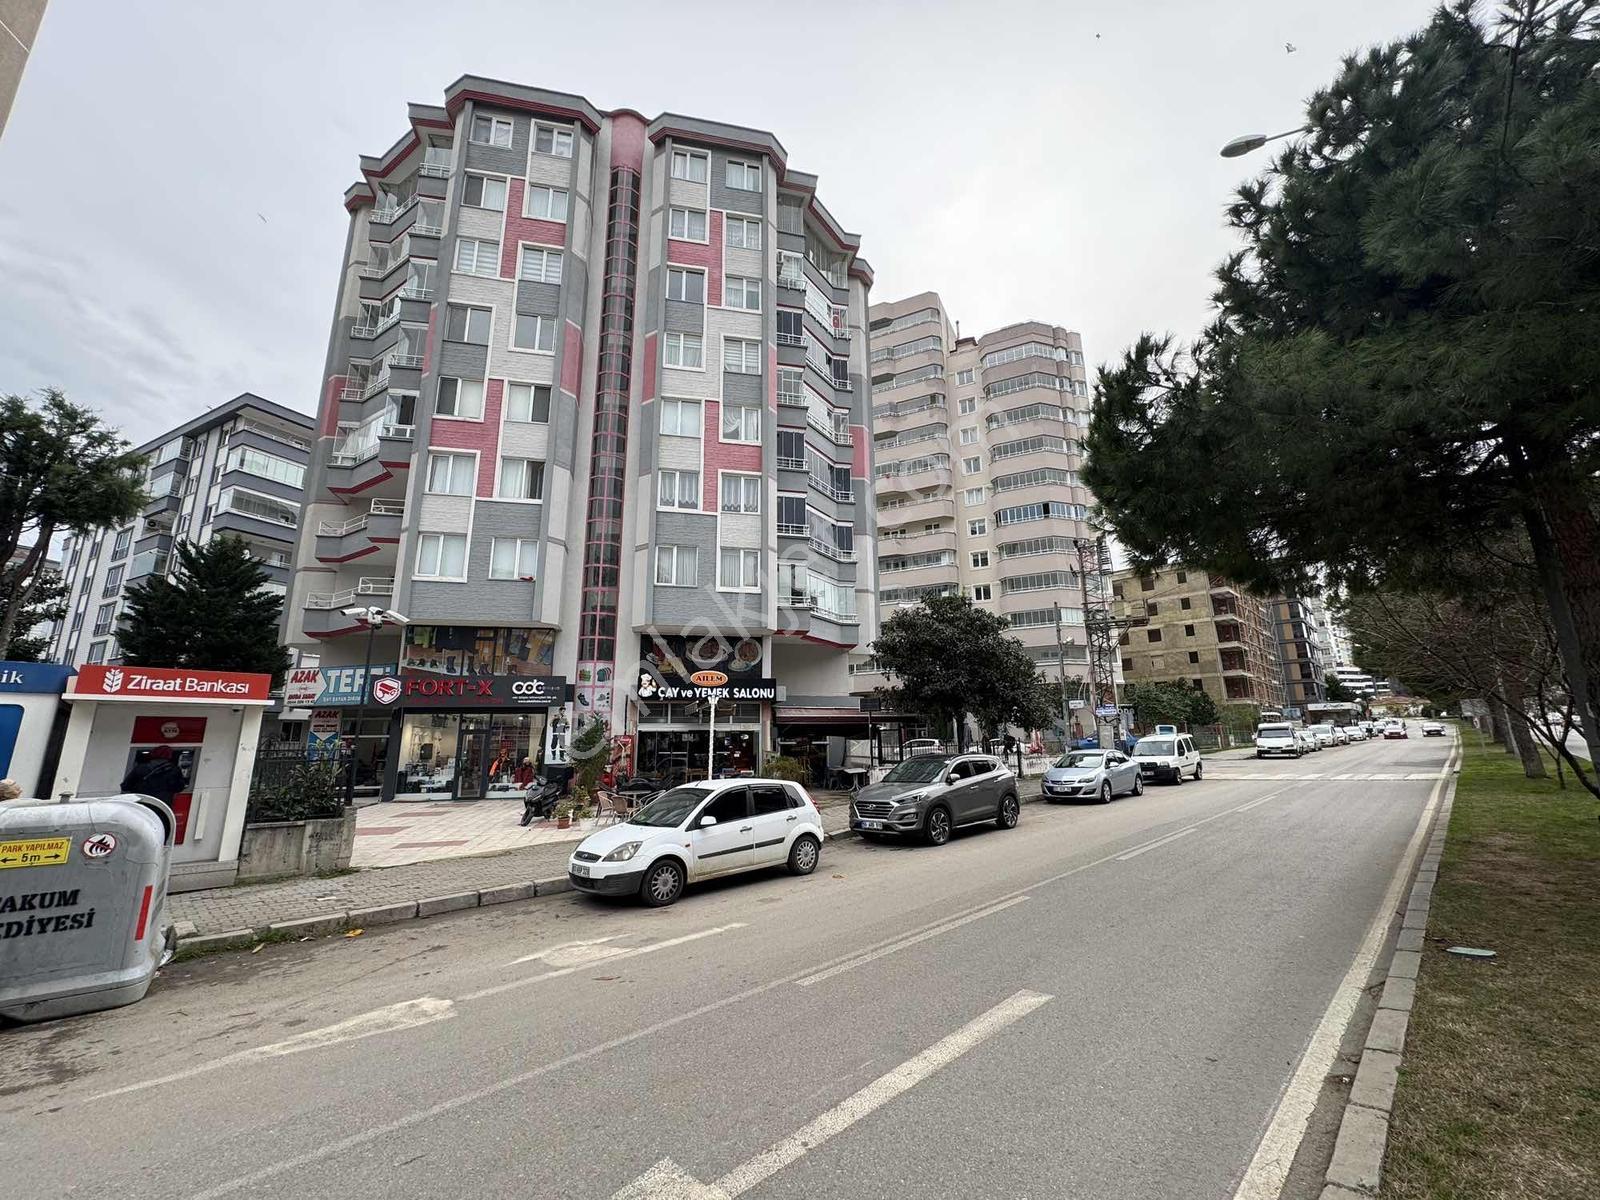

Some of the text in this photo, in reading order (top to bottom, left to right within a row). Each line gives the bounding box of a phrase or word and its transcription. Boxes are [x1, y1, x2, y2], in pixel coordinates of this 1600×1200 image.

[291, 669, 320, 683] AZAK
[127, 675, 249, 694] Ziraat Bankası
[405, 678, 493, 696] FORT-X
[658, 687, 775, 700] ÇAY ve YEMEK SALONU
[1, 841, 65, 854] PARK YAPILMAZ
[0, 889, 81, 913] AKUM
